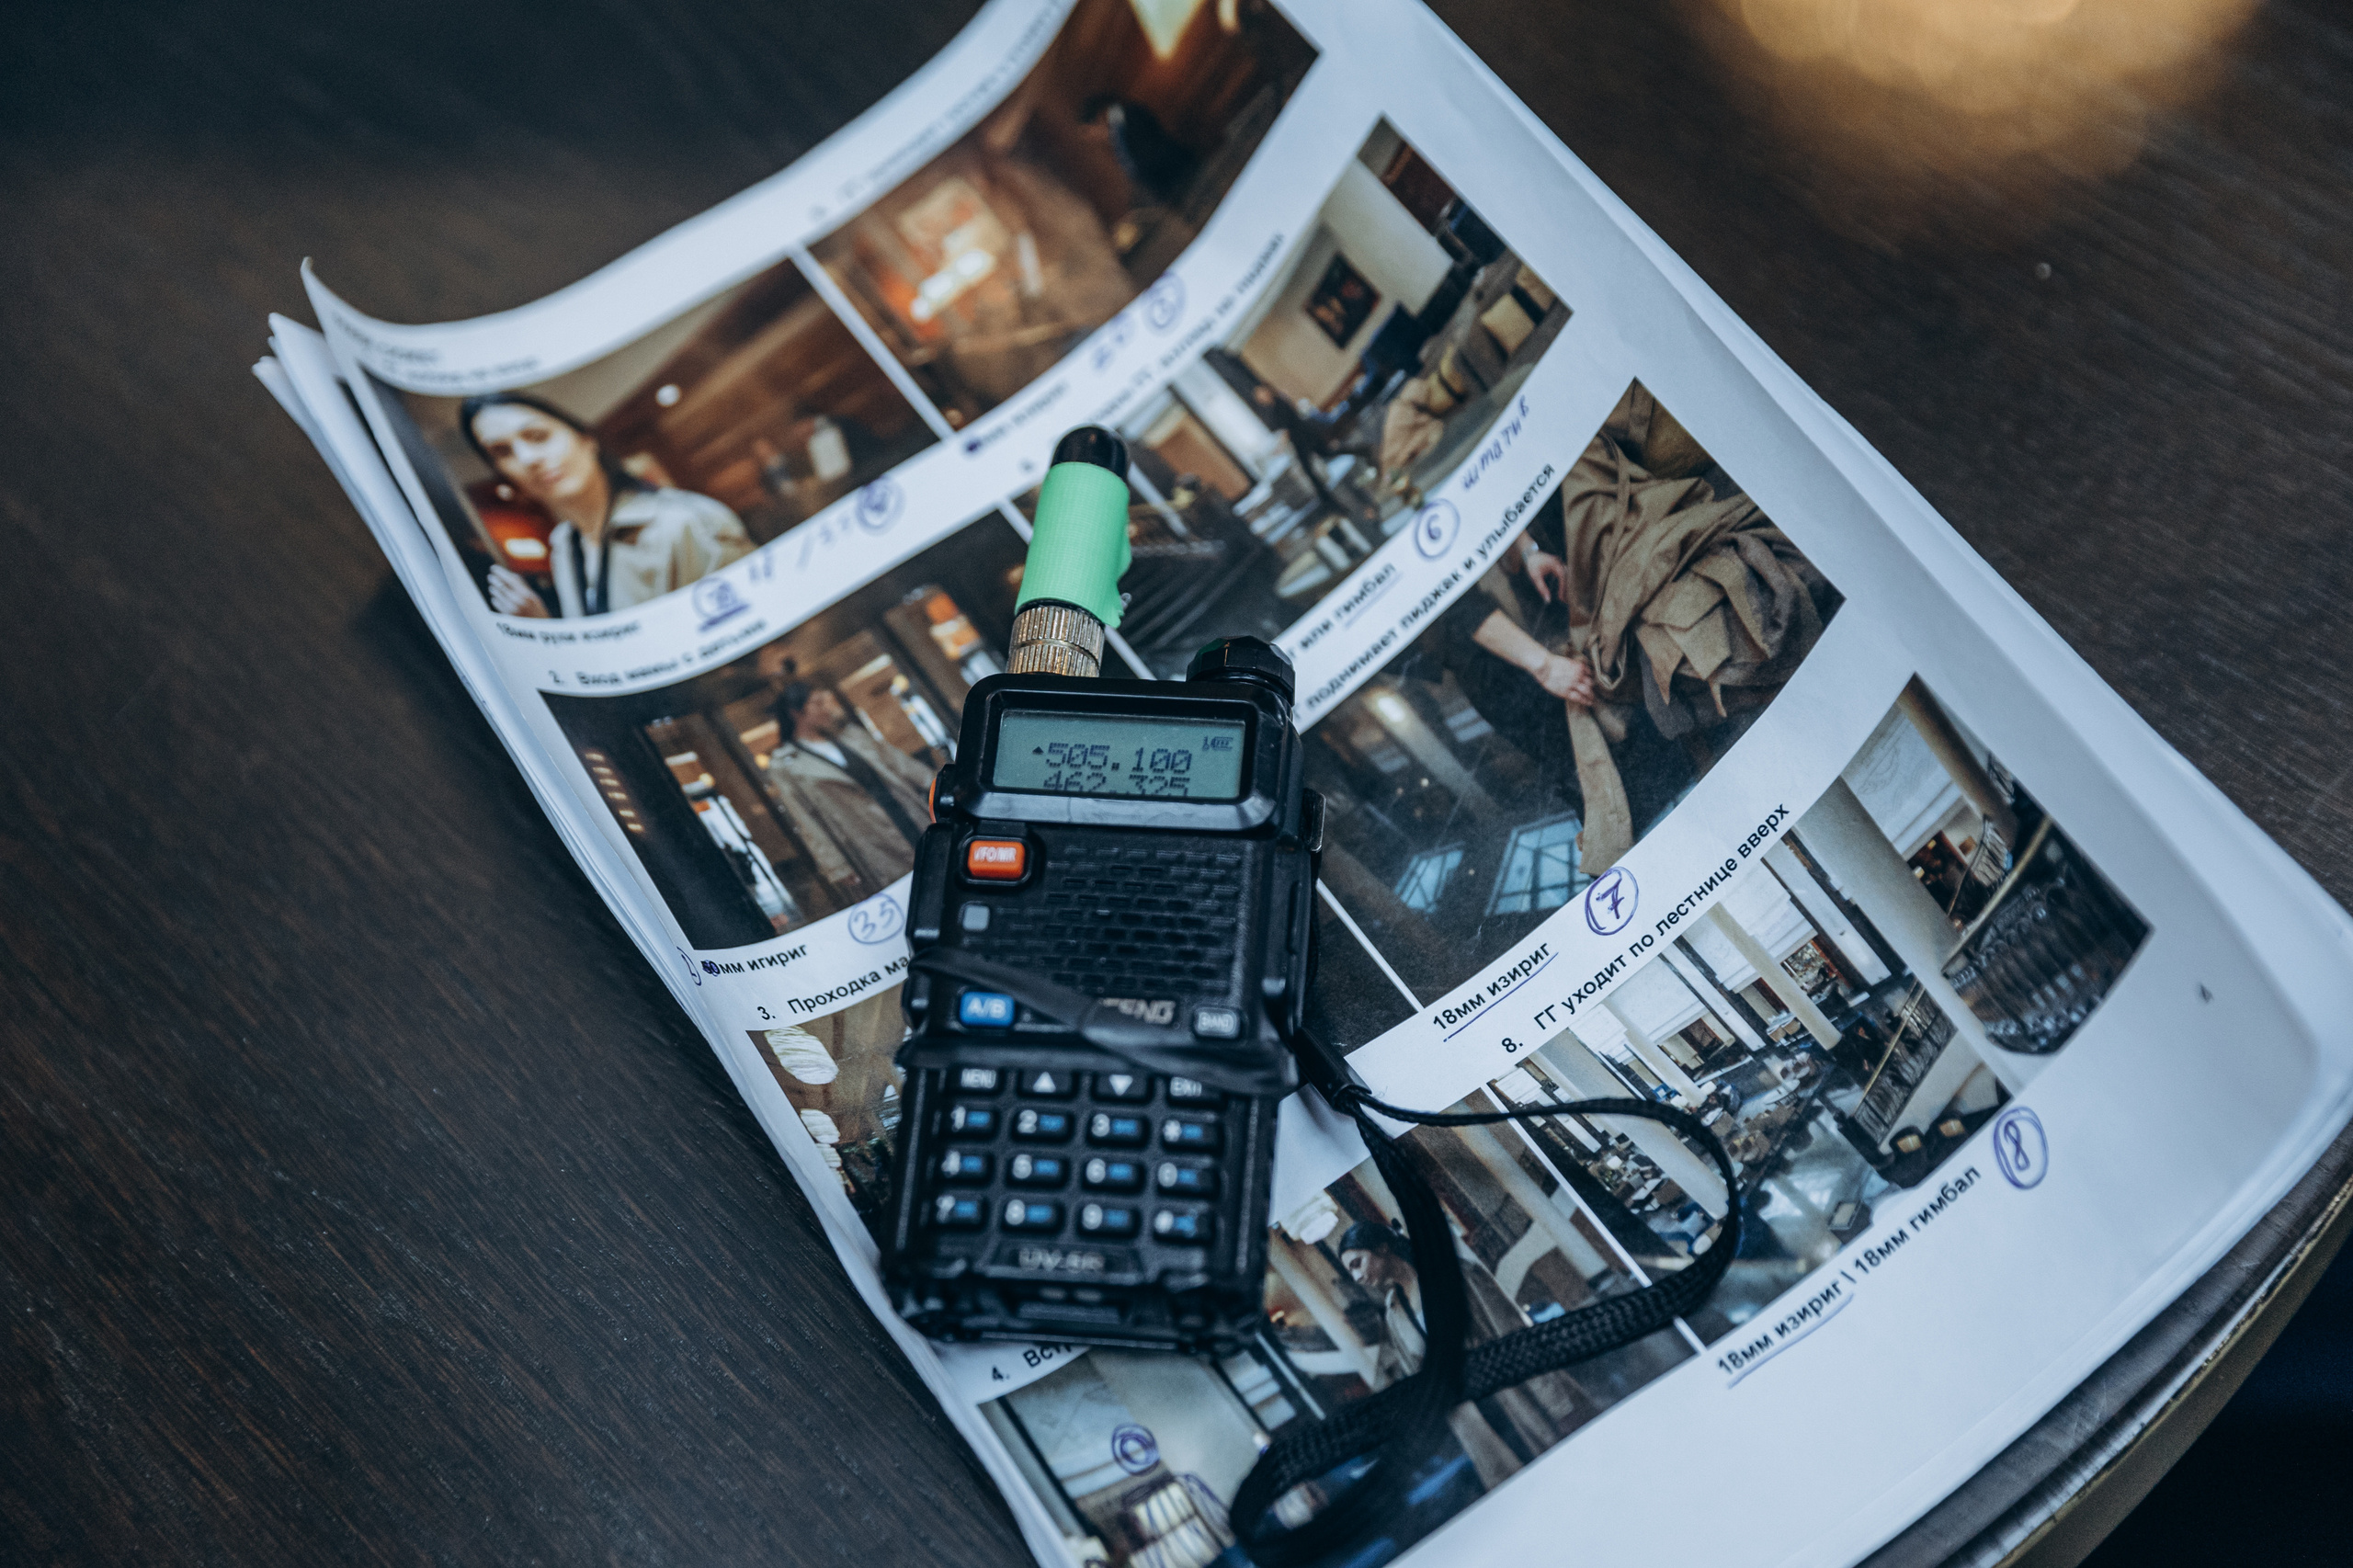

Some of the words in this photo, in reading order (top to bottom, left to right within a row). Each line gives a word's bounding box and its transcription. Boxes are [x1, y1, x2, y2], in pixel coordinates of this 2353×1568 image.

[1305, 629, 1399, 711] поднимает
[1399, 568, 1462, 631] пиджак
[1463, 554, 1478, 572] и
[1475, 463, 1557, 562] улыбается
[1335, 562, 1396, 620] гимбал
[1045, 742, 1193, 775] 505.100
[1500, 1036, 1524, 1054] 8.
[1533, 1003, 1559, 1031] ГГ
[1561, 953, 1628, 1016] уходит
[1628, 932, 1655, 959] по
[1654, 856, 1739, 937] лестнице
[1736, 802, 1791, 859] вверх
[757, 1006, 777, 1020] 3.
[787, 969, 882, 1013] Проходка
[884, 955, 910, 975] ма
[967, 996, 1007, 1020] A/B
[1432, 992, 1486, 1031] 18мм
[1485, 943, 1551, 996] изириг
[961, 1068, 997, 1089] MENU
[1716, 1335, 1775, 1376] 18мм
[1774, 1281, 1842, 1339] изириг
[1853, 1228, 1911, 1276] 18мм
[1908, 1165, 1982, 1233] гимбал
